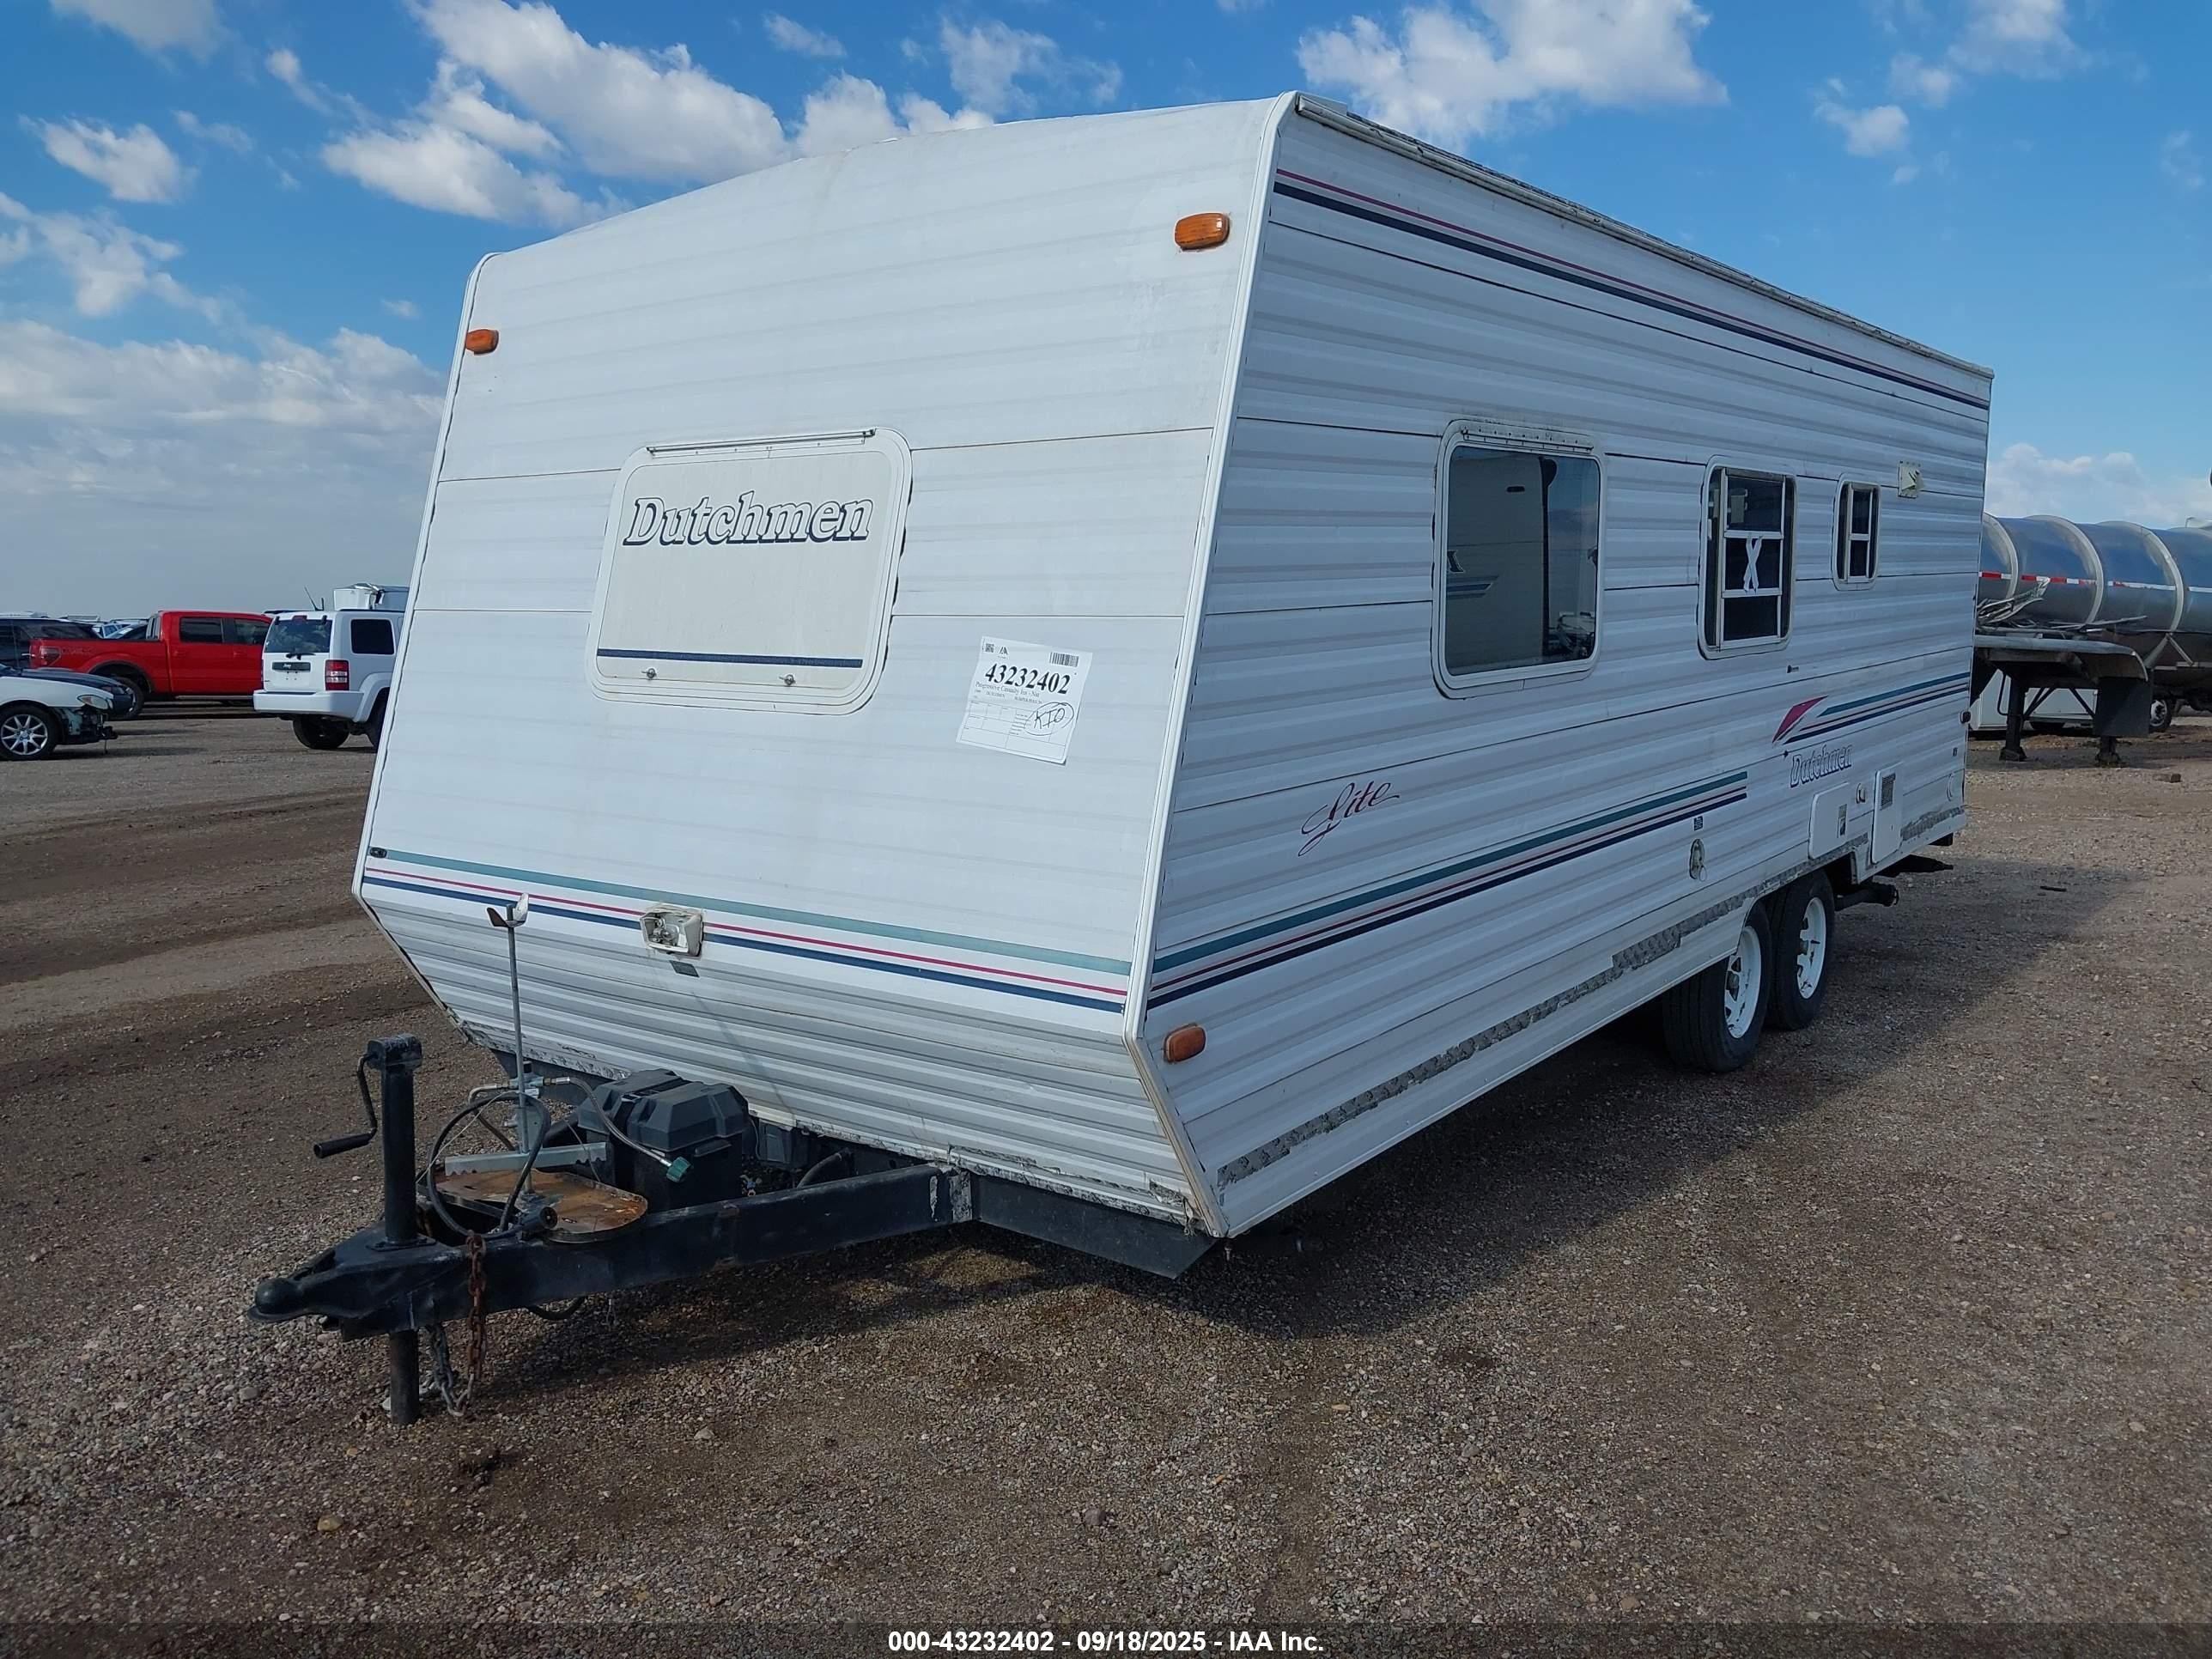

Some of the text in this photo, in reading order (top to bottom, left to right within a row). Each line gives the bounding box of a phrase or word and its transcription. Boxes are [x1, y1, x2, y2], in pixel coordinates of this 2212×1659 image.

[623, 490, 874, 546] Dutchmen
[985, 663, 1071, 695] 43232402
[1790, 744, 1853, 788] Dutchmen
